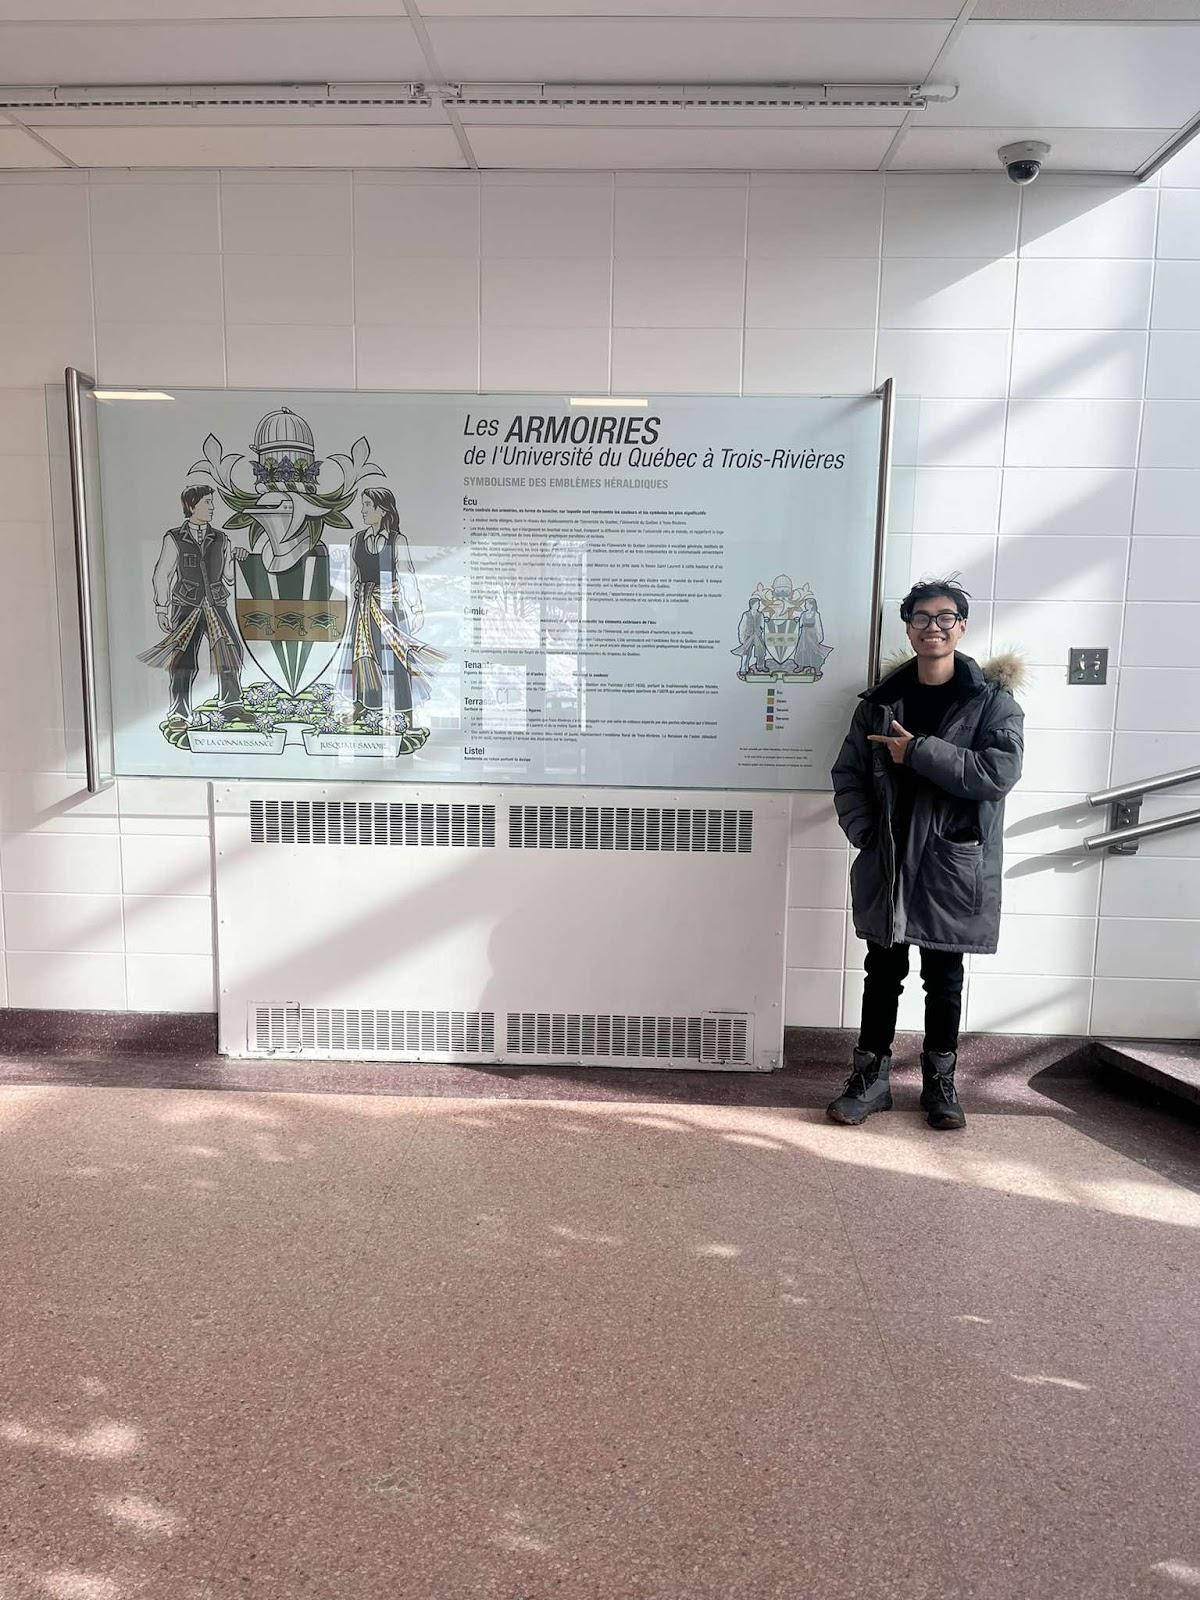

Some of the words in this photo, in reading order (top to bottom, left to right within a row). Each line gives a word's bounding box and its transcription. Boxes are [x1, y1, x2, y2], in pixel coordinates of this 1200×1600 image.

[463, 414, 499, 436] Les
[504, 415, 661, 445] ARMOIRIES
[464, 446, 486, 465] de
[492, 446, 593, 467] l'Université
[599, 447, 622, 467] du
[628, 447, 698, 468] Québec
[702, 447, 714, 468] à
[721, 448, 845, 469] Trois-Rivières
[463, 477, 526, 487] SYMBOLISME
[528, 477, 547, 488] DES
[604, 476, 669, 489] HÉRALDIQUES
[463, 495, 478, 506] Écu
[464, 746, 485, 755] Listel
